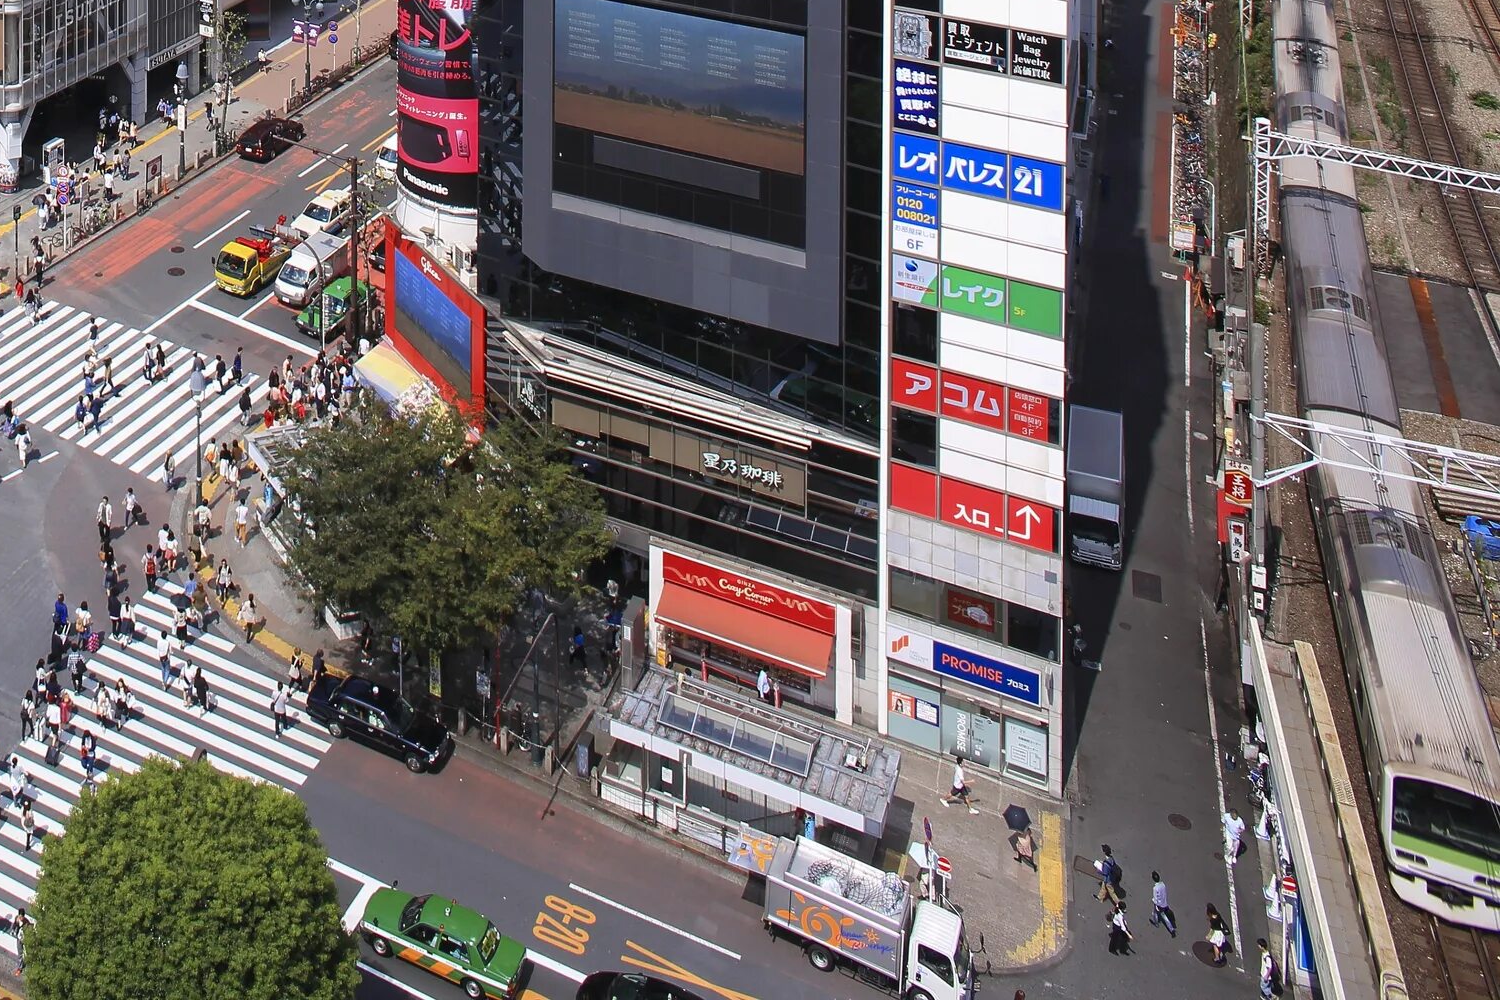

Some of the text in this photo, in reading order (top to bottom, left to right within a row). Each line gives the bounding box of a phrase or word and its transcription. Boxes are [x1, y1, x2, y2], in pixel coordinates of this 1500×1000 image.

[947, 21, 970, 38] 買取
[1016, 31, 1048, 45] Watch
[947, 34, 1005, 55] エージェント
[1023, 43, 1041, 57] Bag
[1013, 53, 1050, 70] Jewelry
[896, 66, 938, 86] 絶対に
[1013, 66, 1050, 81] 高価買取
[897, 111, 938, 128] ここにある
[403, 166, 448, 196] Panasonic
[896, 185, 937, 200] フリーコール
[897, 195, 923, 210] 0120
[896, 208, 936, 225] 008021
[906, 237, 924, 251] 6F
[421, 256, 442, 281] Glico
[943, 276, 1004, 307] レイク
[1013, 306, 1027, 317] 5F
[905, 371, 1001, 418] アコム
[1021, 402, 1035, 413] 4F
[1013, 413, 1042, 427] 自動契約
[1021, 428, 1035, 437] 3F
[701, 451, 782, 489] 星乃珈琲
[1231, 474, 1247, 499] 王将
[954, 502, 990, 529] 入口
[718, 577, 774, 603] Cozy Corner
[736, 578, 756, 589] GINZA
[942, 653, 1003, 685] PROMISE
[1006, 677, 1031, 693] プロミス
[955, 711, 967, 753] PROMISE
